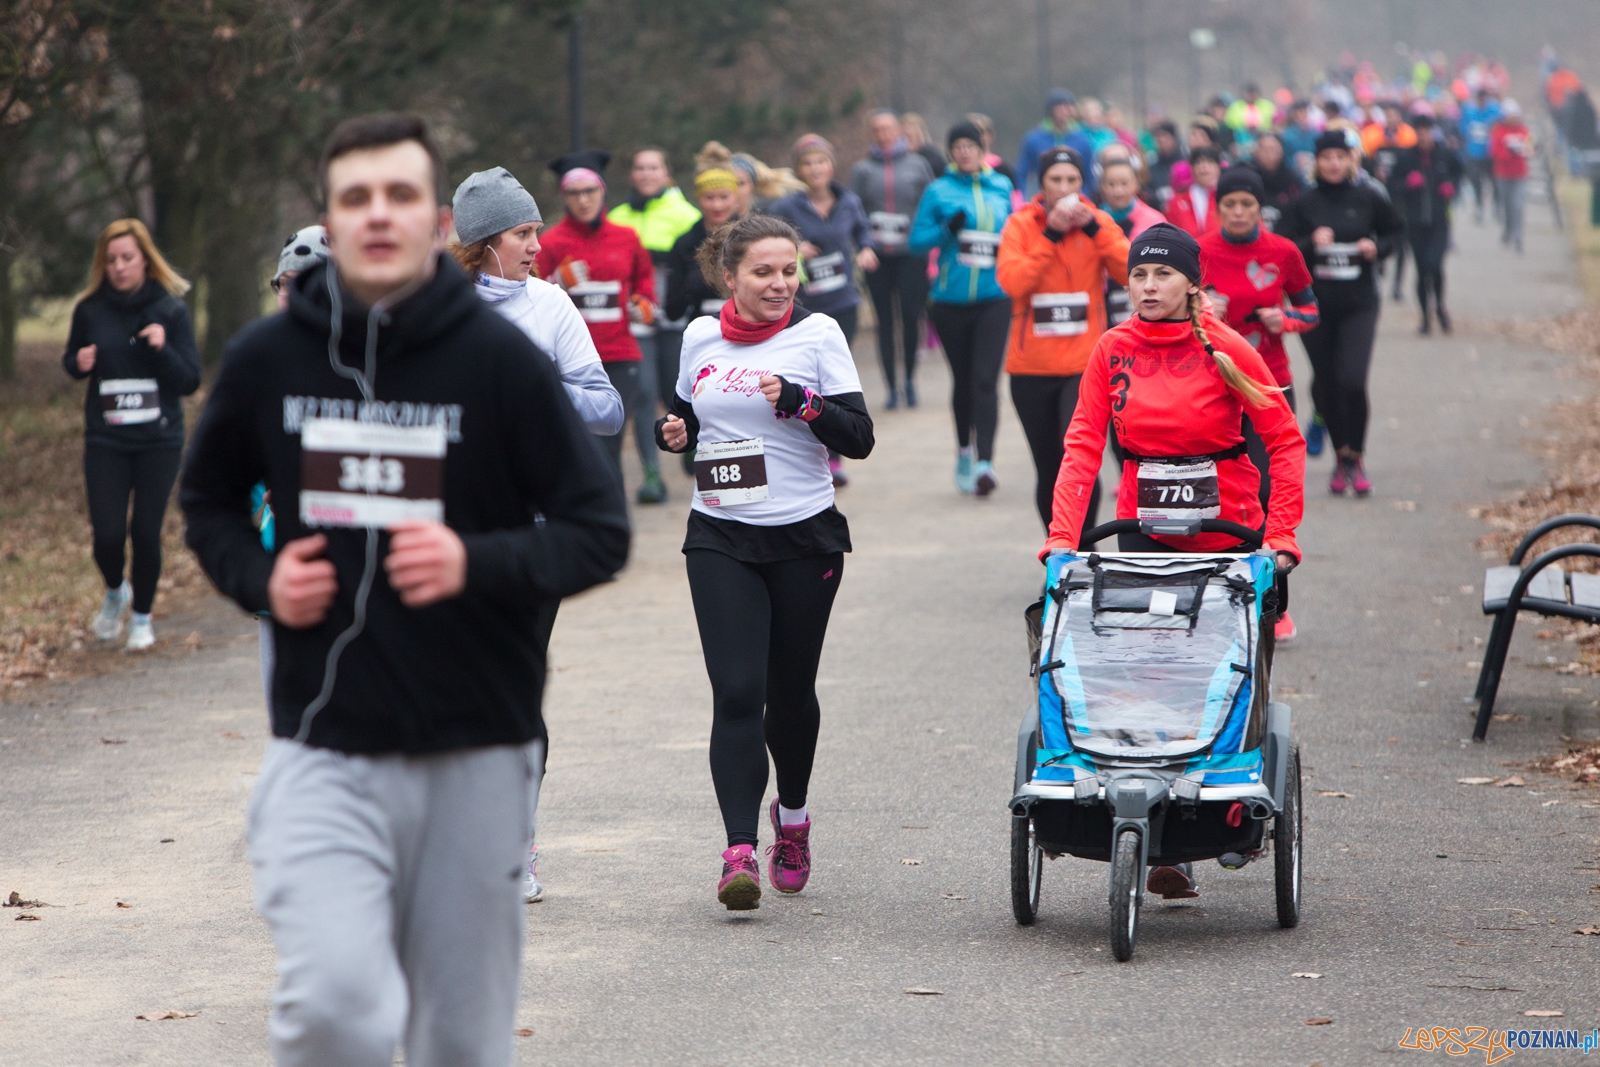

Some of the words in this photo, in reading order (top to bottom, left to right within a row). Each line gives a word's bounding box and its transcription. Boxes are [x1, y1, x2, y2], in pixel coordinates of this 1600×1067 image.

[1149, 247, 1169, 256] asics
[1110, 355, 1137, 369] PW
[1109, 371, 1131, 412] 3
[710, 464, 741, 484] 188
[1156, 484, 1195, 503] 770
